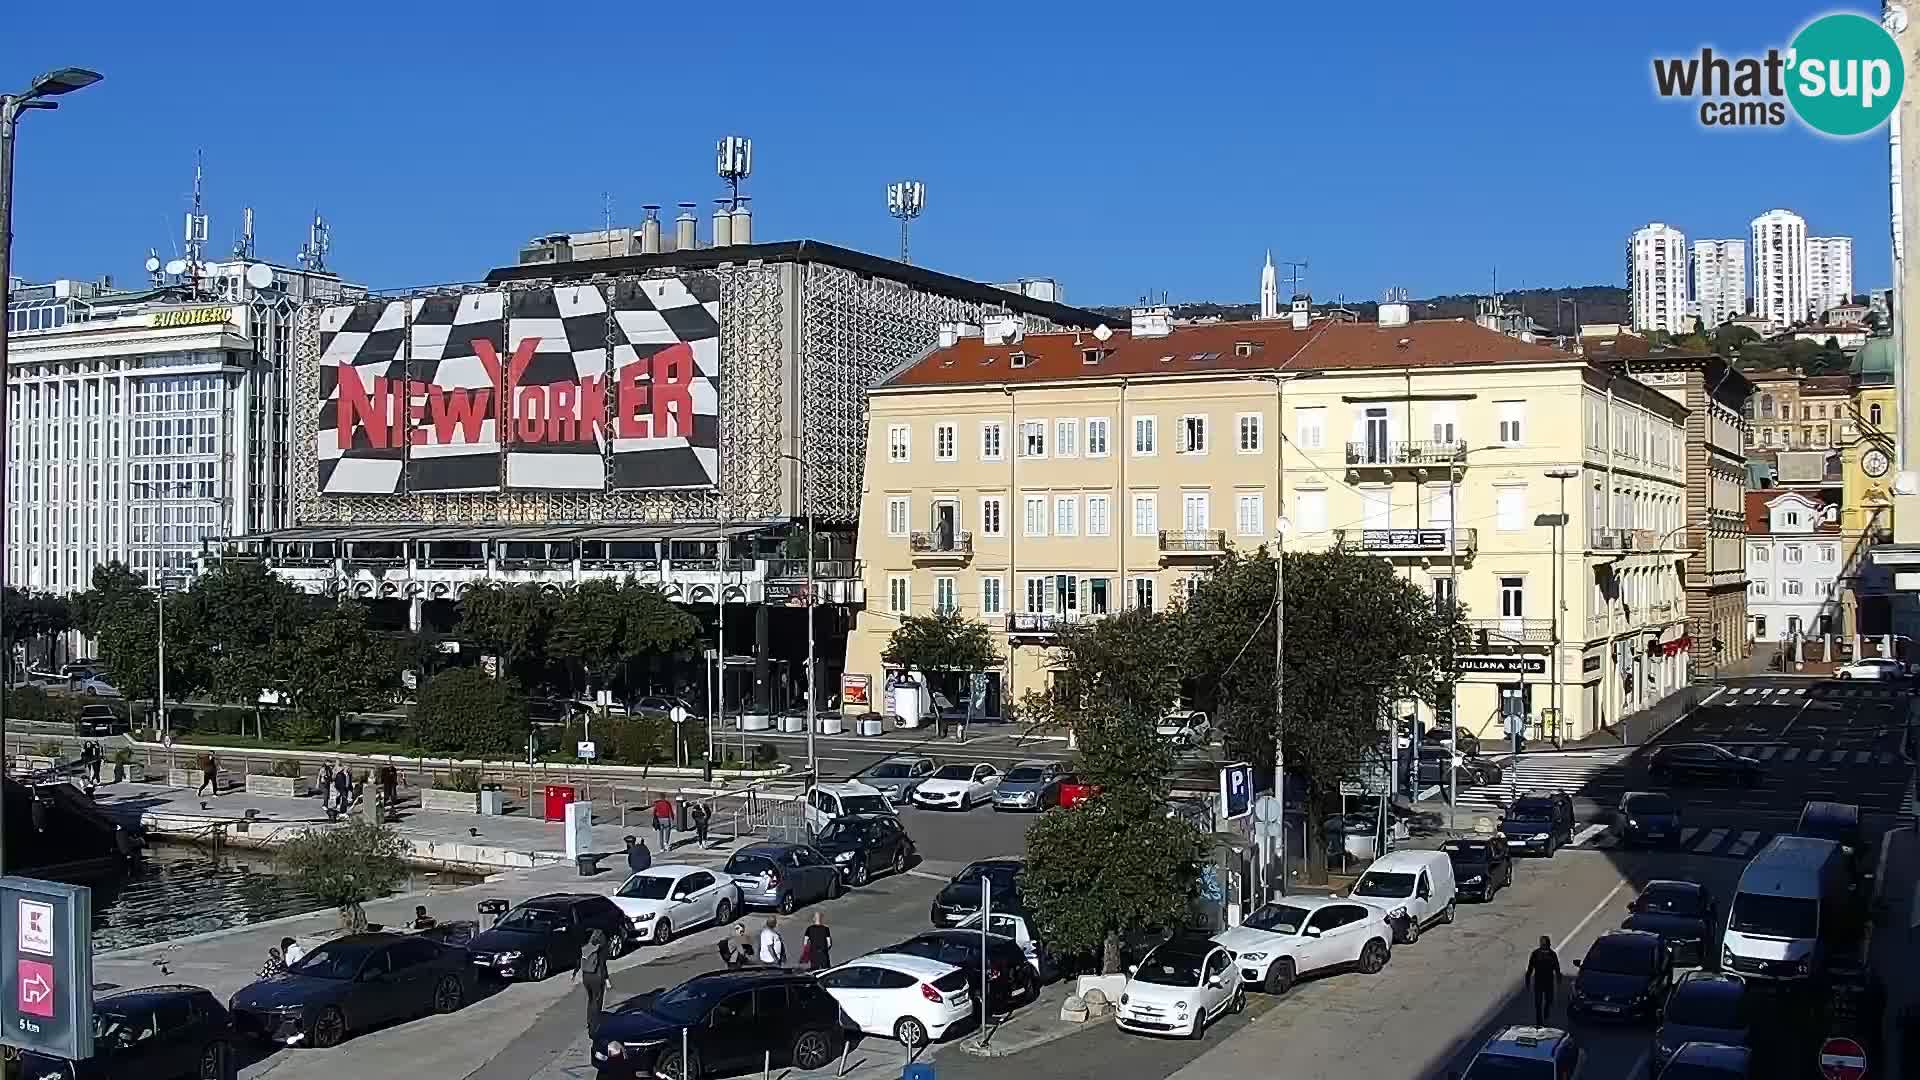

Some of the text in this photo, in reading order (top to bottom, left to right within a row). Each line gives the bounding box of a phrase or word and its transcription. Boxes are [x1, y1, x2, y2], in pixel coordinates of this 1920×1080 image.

[337, 336, 694, 449] NEW YORKER
[1459, 661, 1541, 670] JULIANA NAILS
[19, 1018, 40, 1033] 5 km
